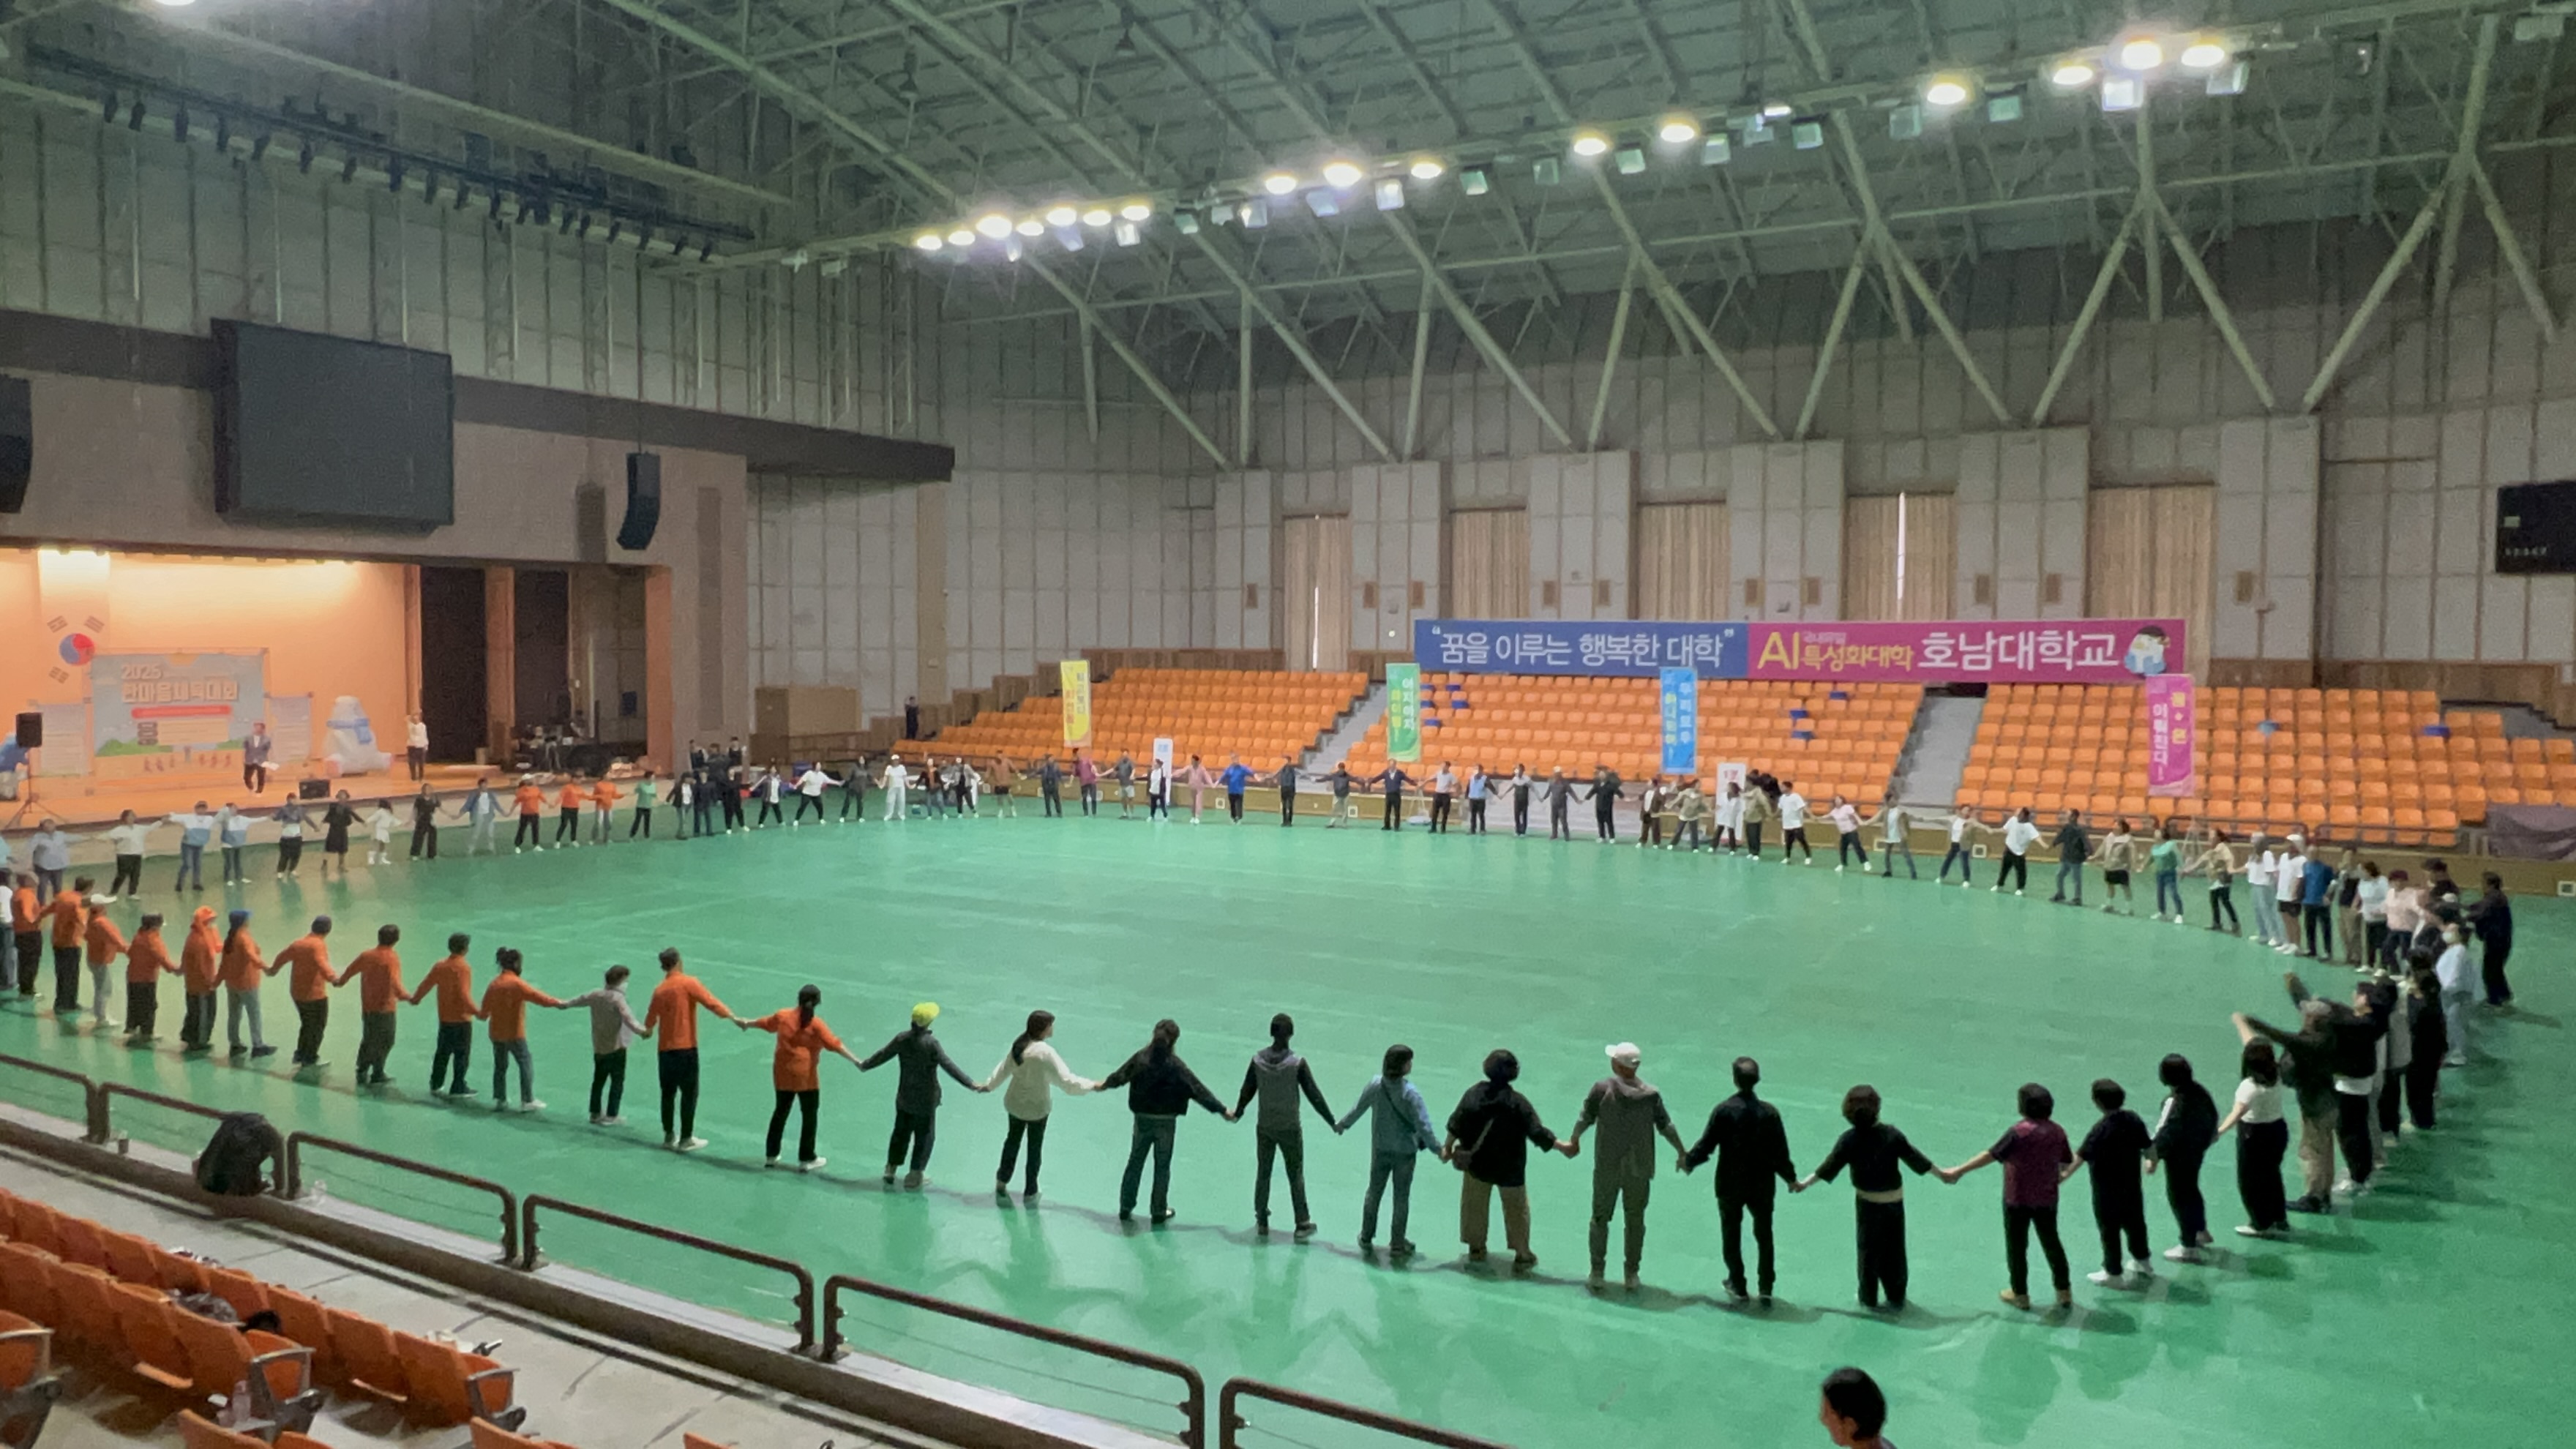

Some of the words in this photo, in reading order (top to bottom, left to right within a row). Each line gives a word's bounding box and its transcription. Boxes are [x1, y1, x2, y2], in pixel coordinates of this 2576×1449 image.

[1495, 631, 1573, 665] 이루는
[1579, 632, 1662, 666] 행복한
[1757, 632, 1800, 670] AI
[1802, 644, 1914, 672] 특성화대학
[1919, 631, 2119, 671] 호남대학교
[121, 664, 163, 680] 2025
[121, 681, 239, 703] 한마음체육대회
